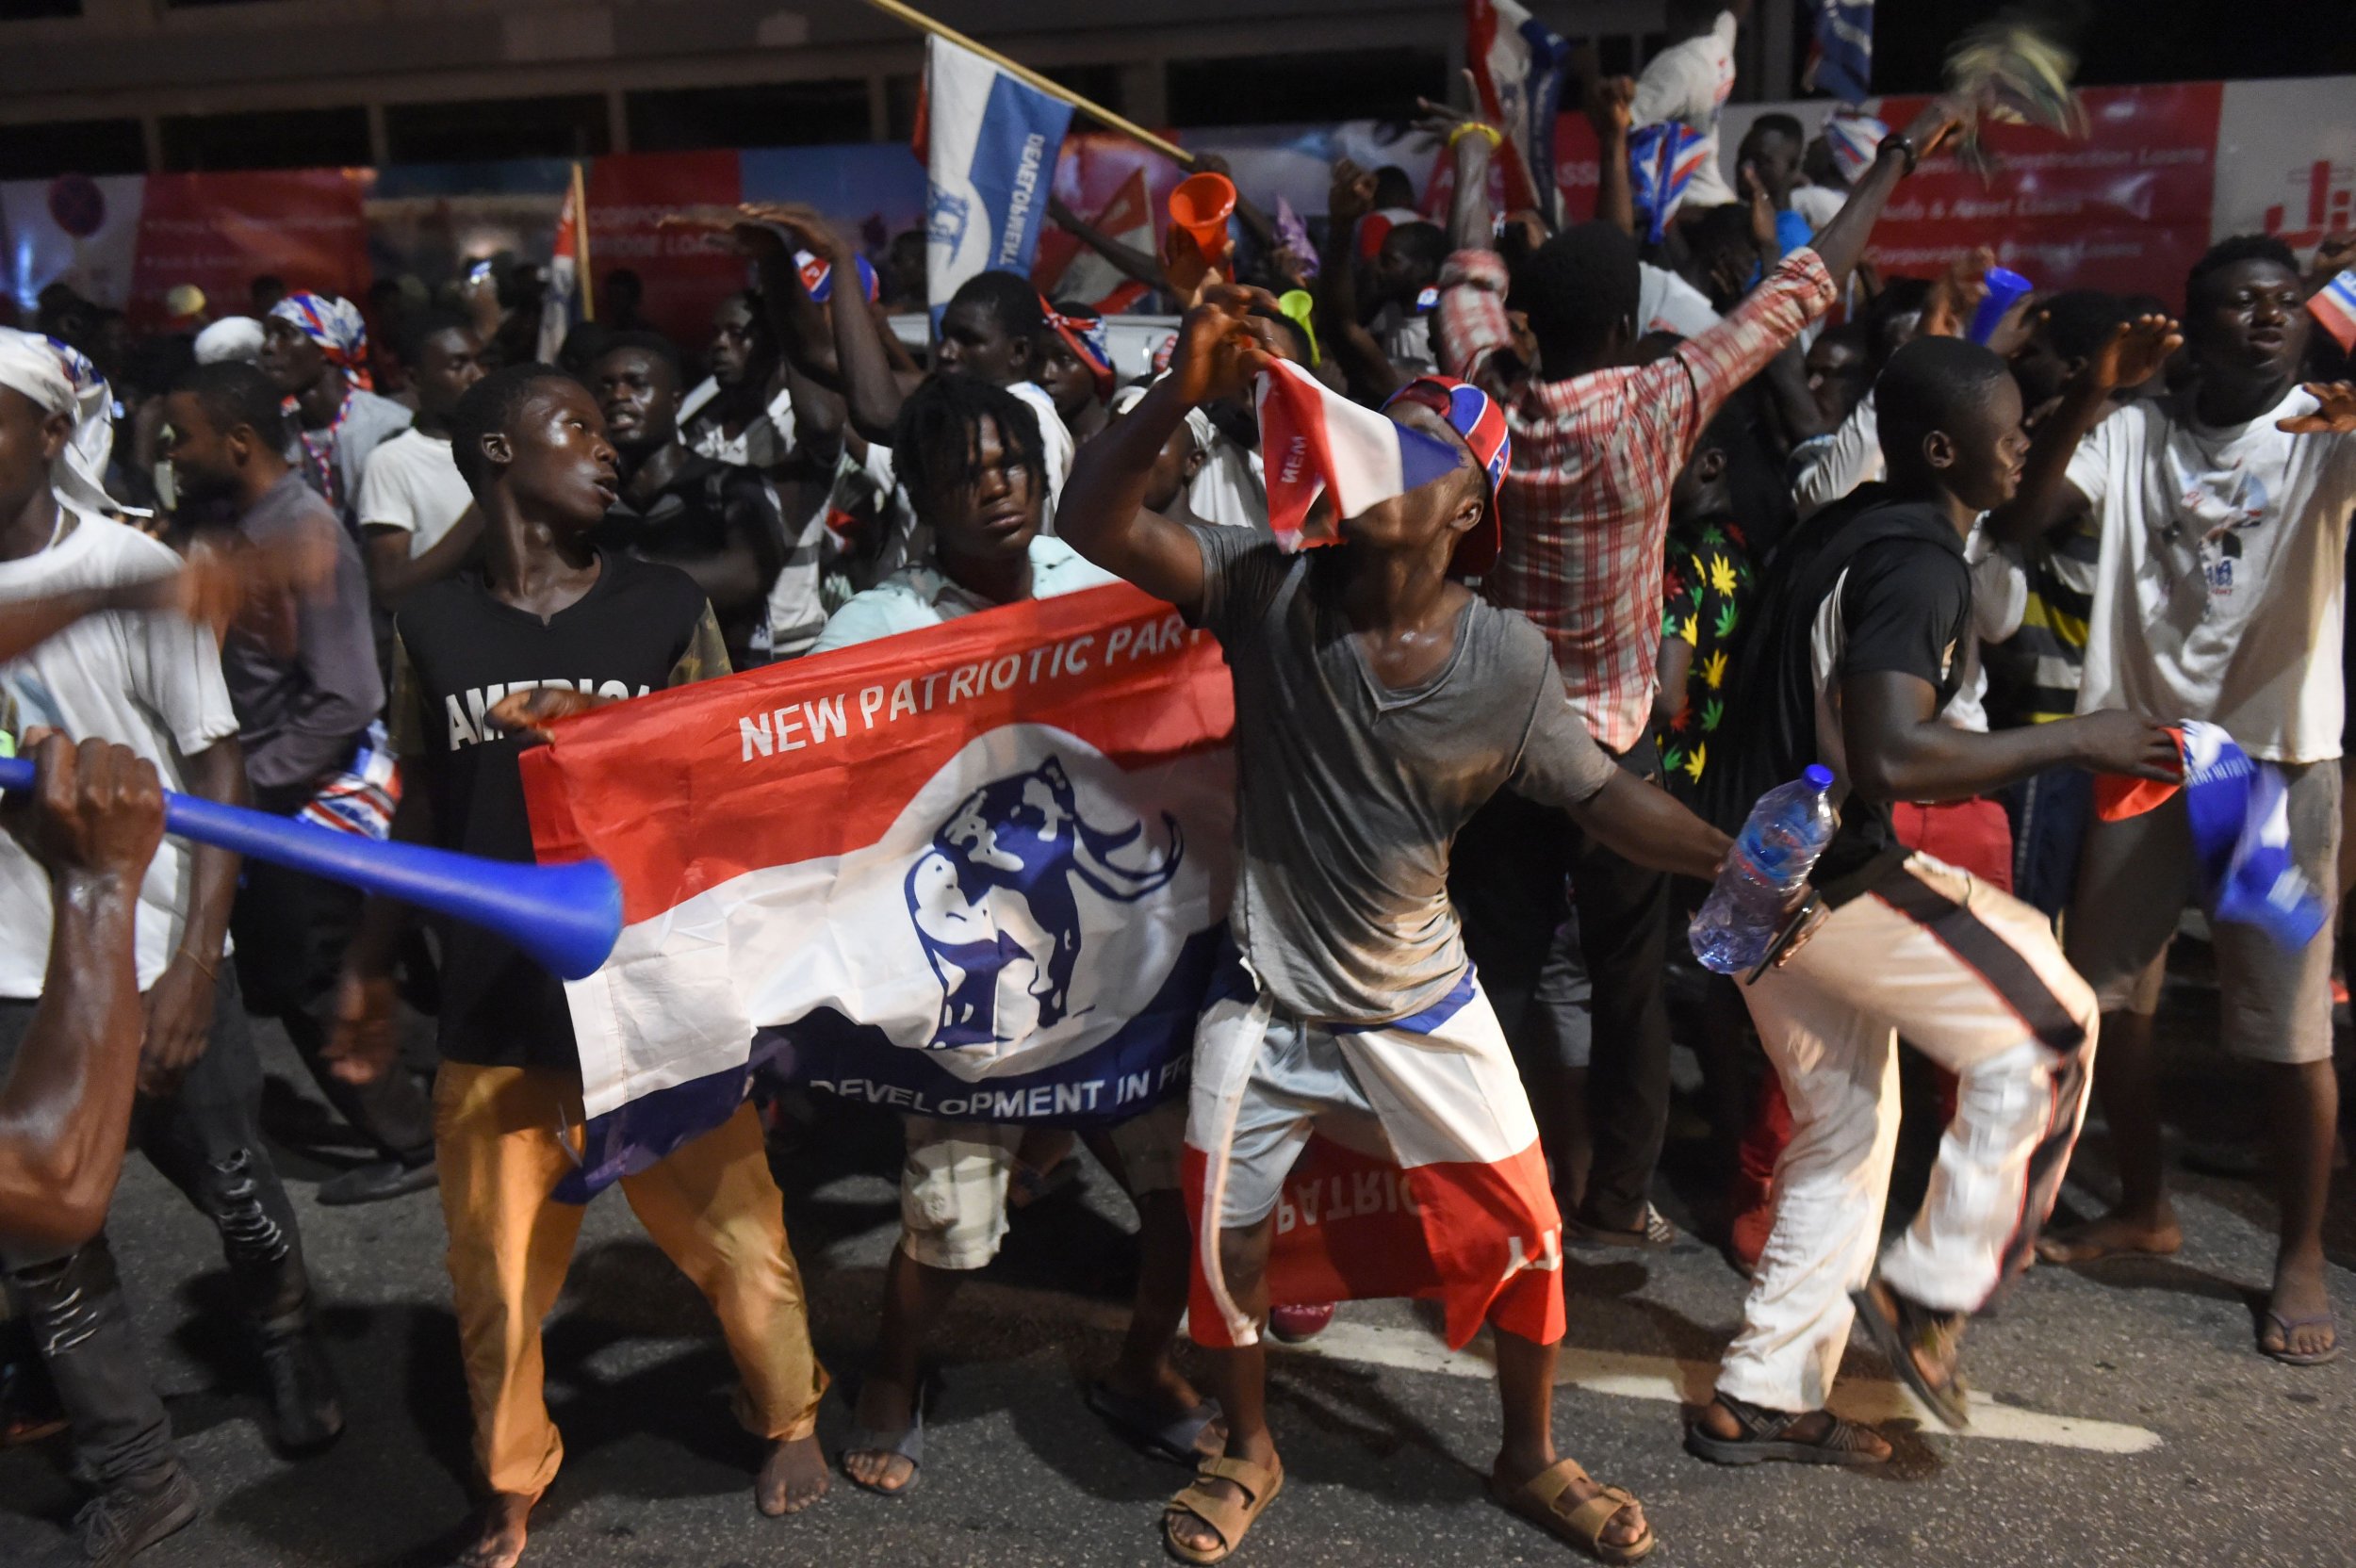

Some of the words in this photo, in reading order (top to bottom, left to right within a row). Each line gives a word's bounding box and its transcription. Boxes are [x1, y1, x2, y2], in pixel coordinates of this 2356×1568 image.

[739, 694, 847, 762] NEW
[859, 635, 1094, 729] PATRIOTIC
[1116, 1069, 1150, 1105] IN
